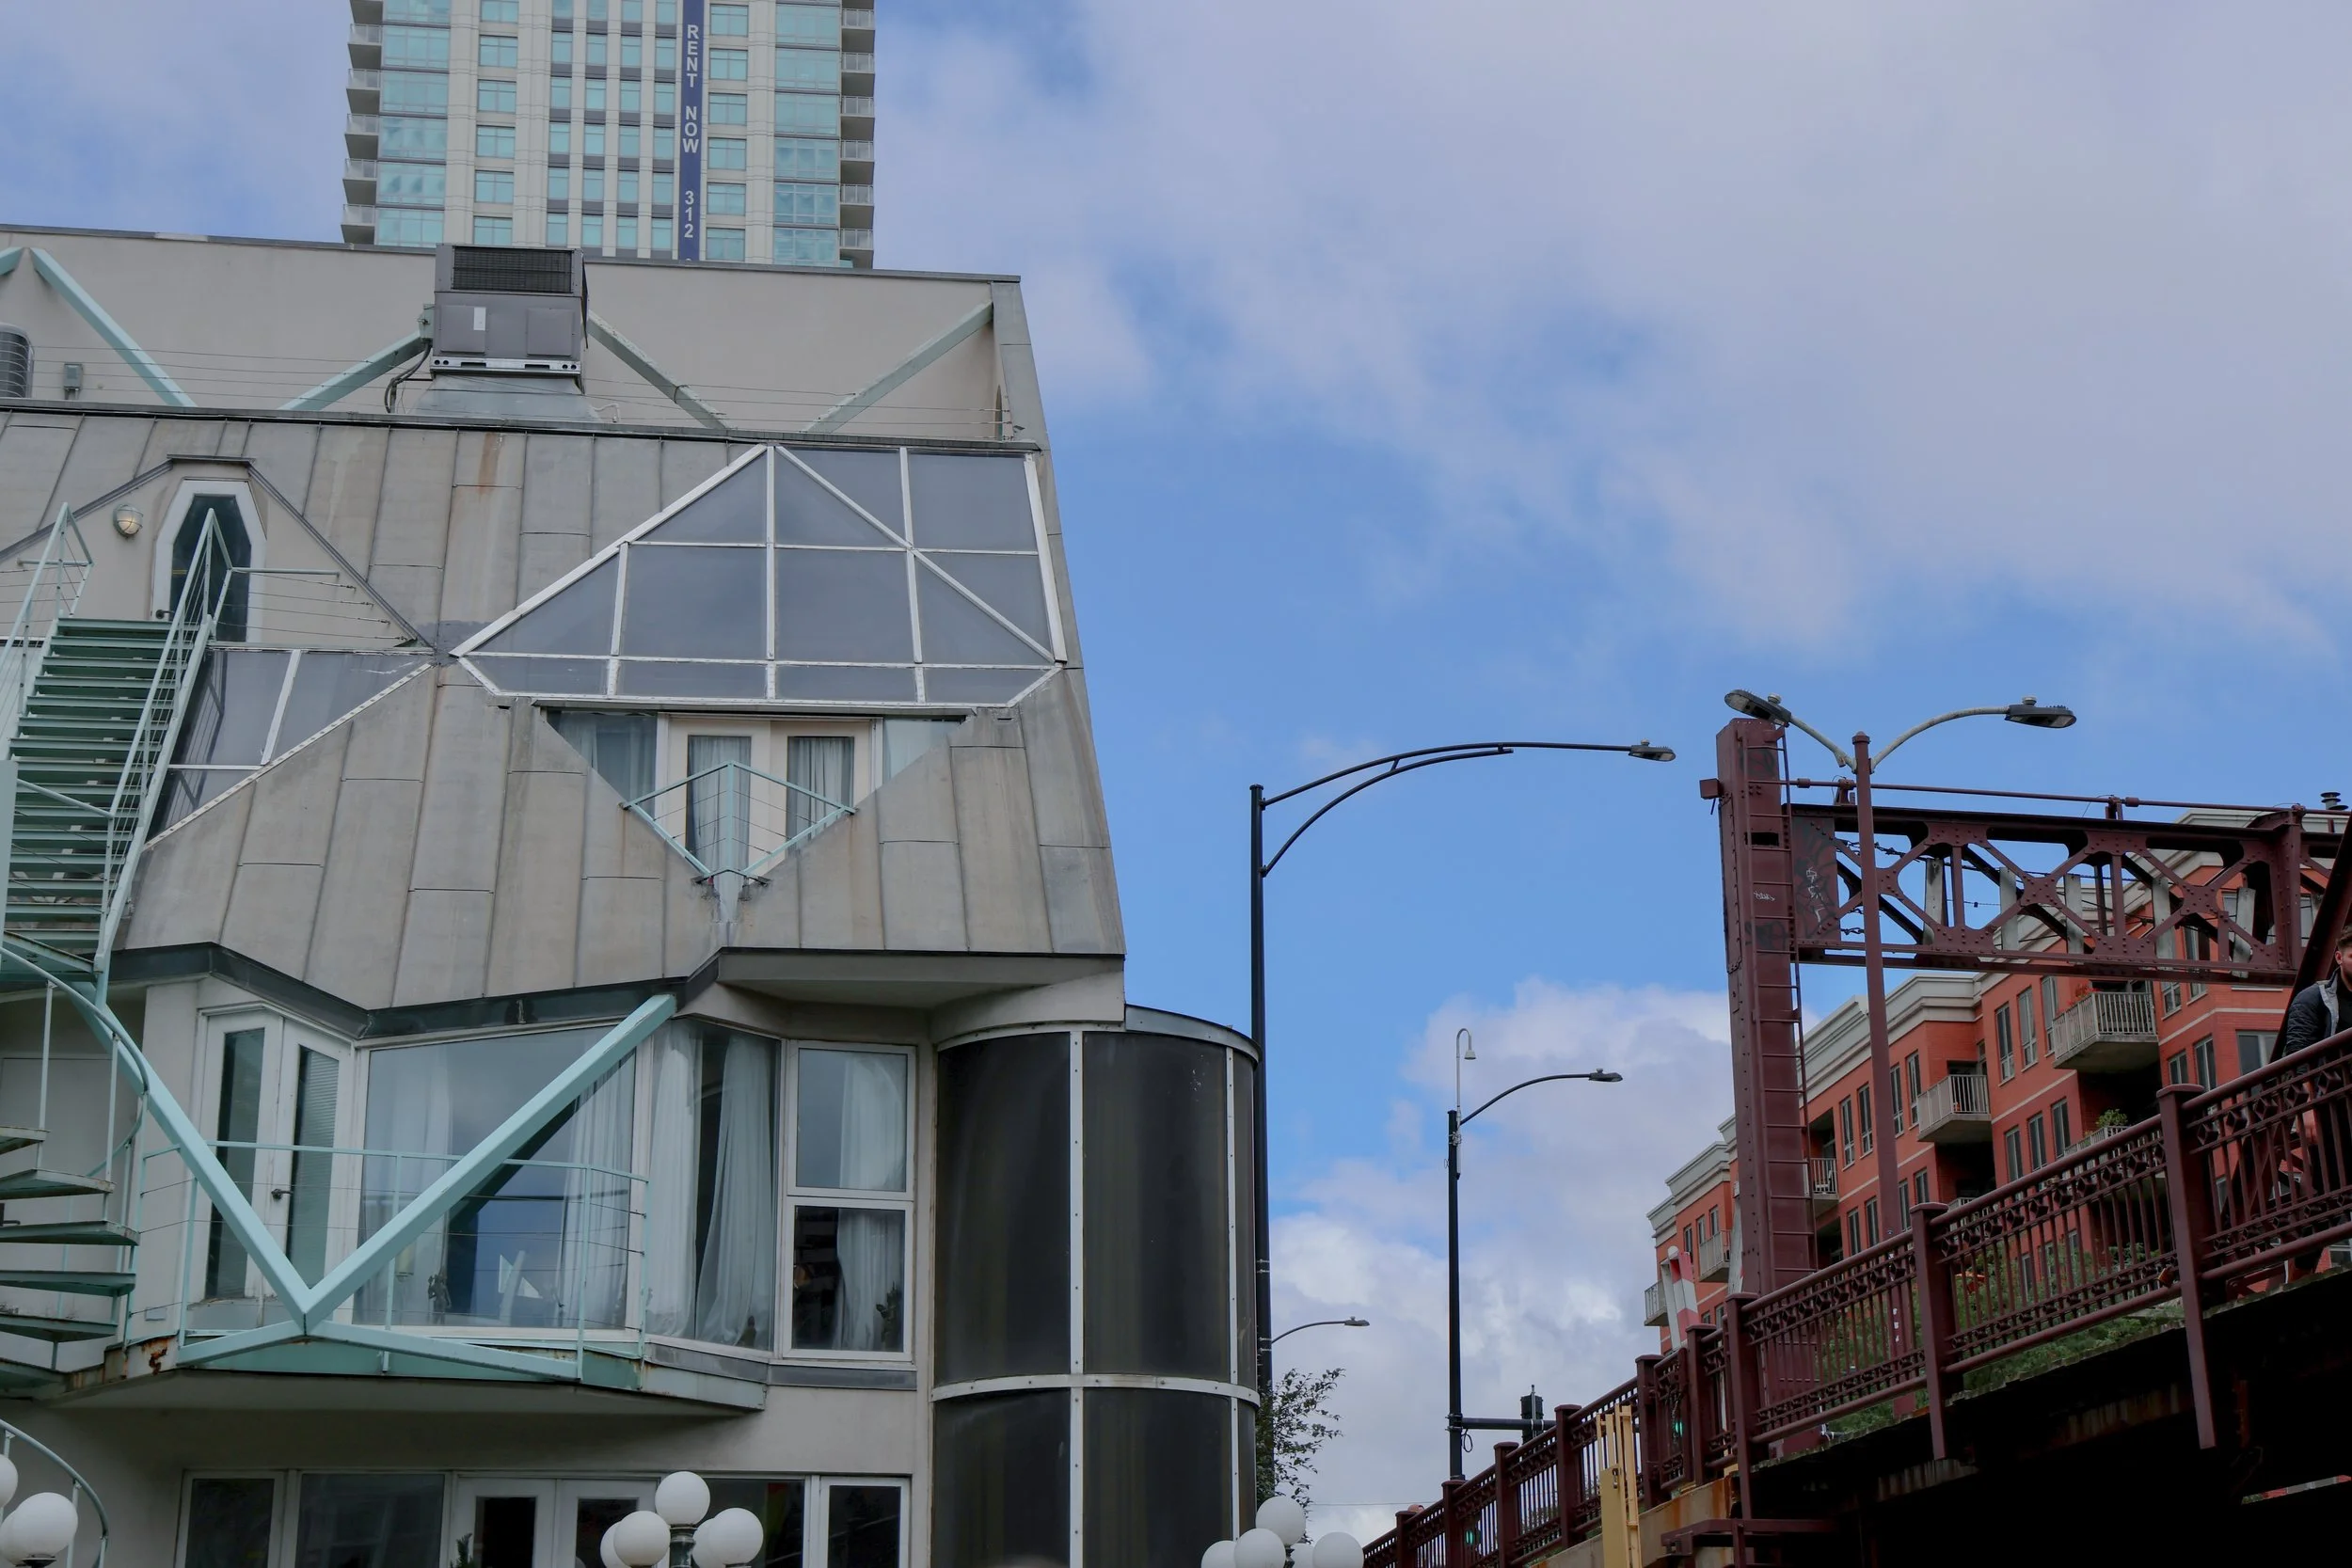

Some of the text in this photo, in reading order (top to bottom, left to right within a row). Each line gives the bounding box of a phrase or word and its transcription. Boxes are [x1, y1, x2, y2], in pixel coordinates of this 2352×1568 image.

[682, 24, 699, 238] RENT NOW 312
